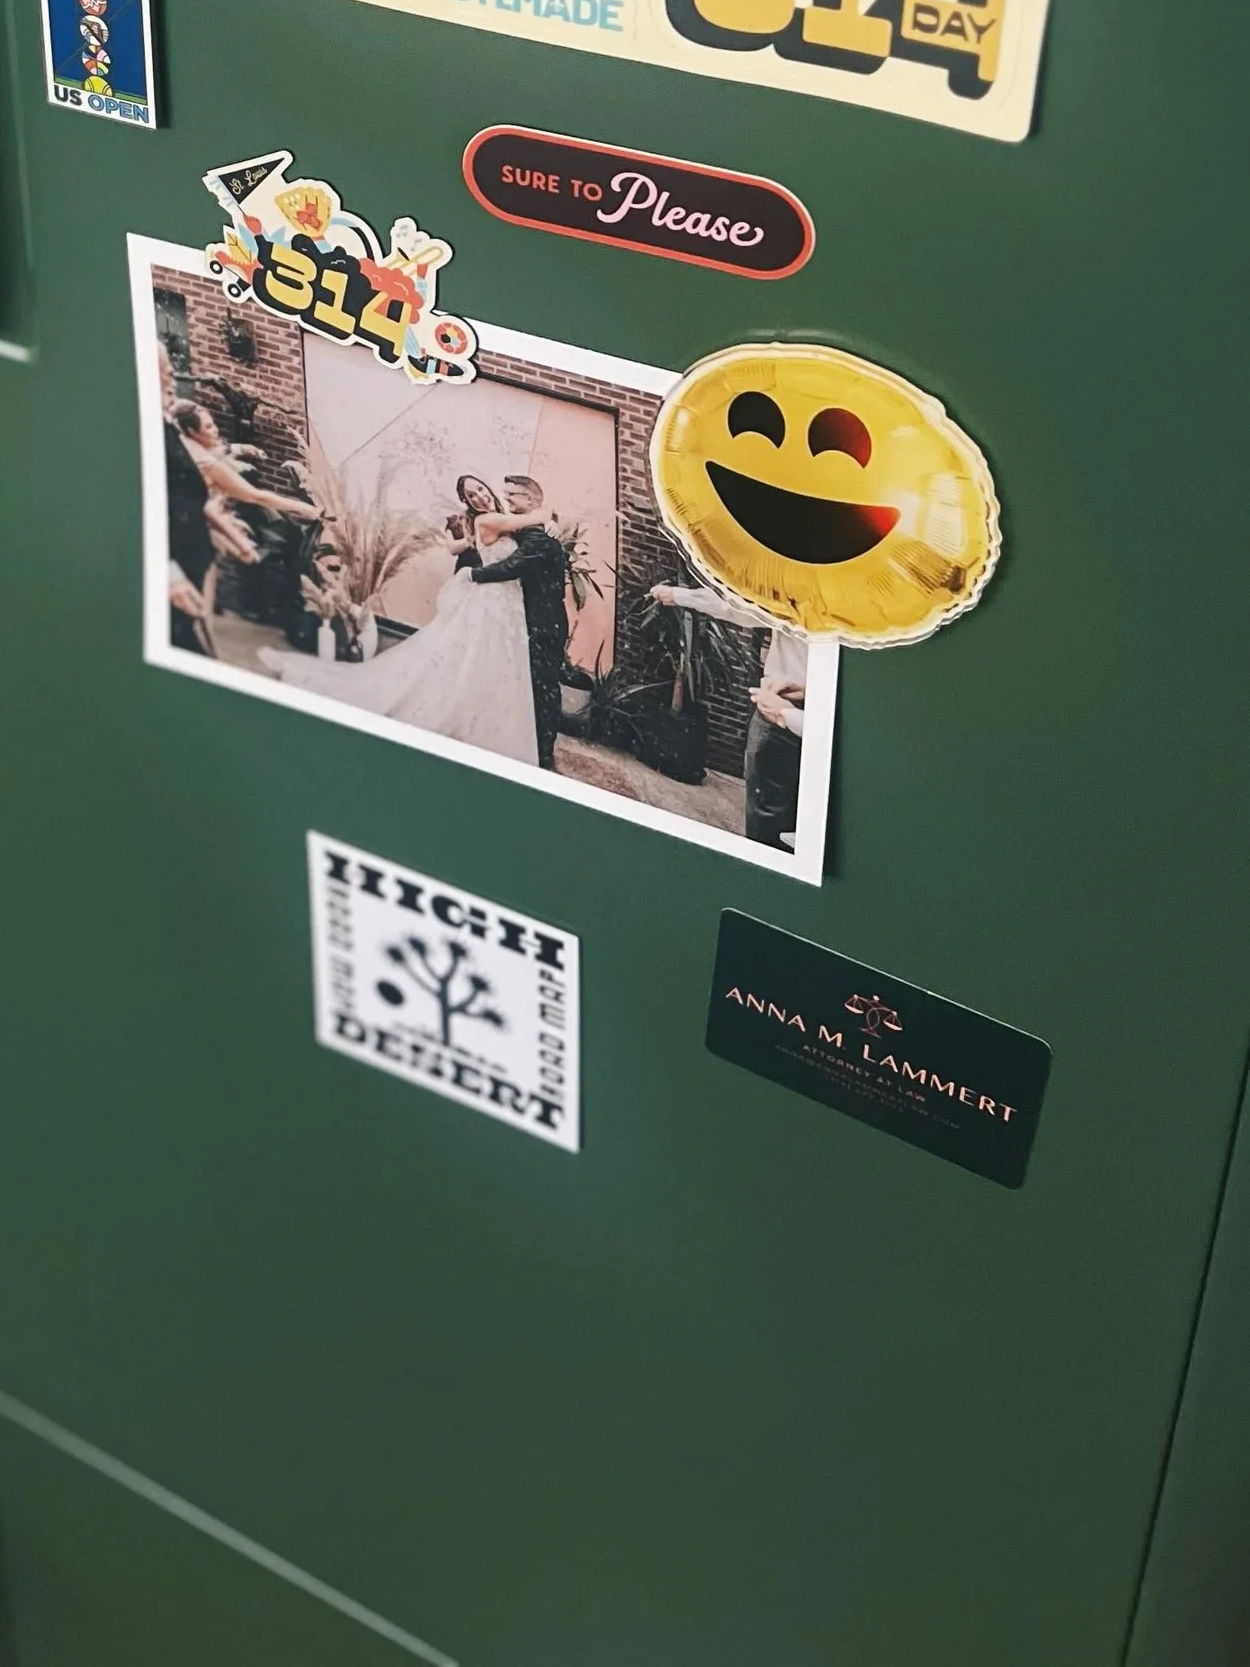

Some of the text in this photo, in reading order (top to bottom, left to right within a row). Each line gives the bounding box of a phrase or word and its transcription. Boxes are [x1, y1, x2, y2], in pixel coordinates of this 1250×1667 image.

[910, 3, 998, 44] DAY
[53, 84, 150, 124] US OPEN
[501, 165, 765, 247] SURE TO Please
[256, 245, 412, 362] 314
[325, 850, 565, 971] HIGH
[335, 1012, 565, 1130] DESERT
[726, 986, 806, 1032] ANNA
[818, 1024, 847, 1051] M.
[862, 1043, 1018, 1123] LAMMERT
[801, 1044, 871, 1078] ATTORNEY
[876, 1076, 892, 1087] AT
[898, 1085, 926, 1102] LAW
